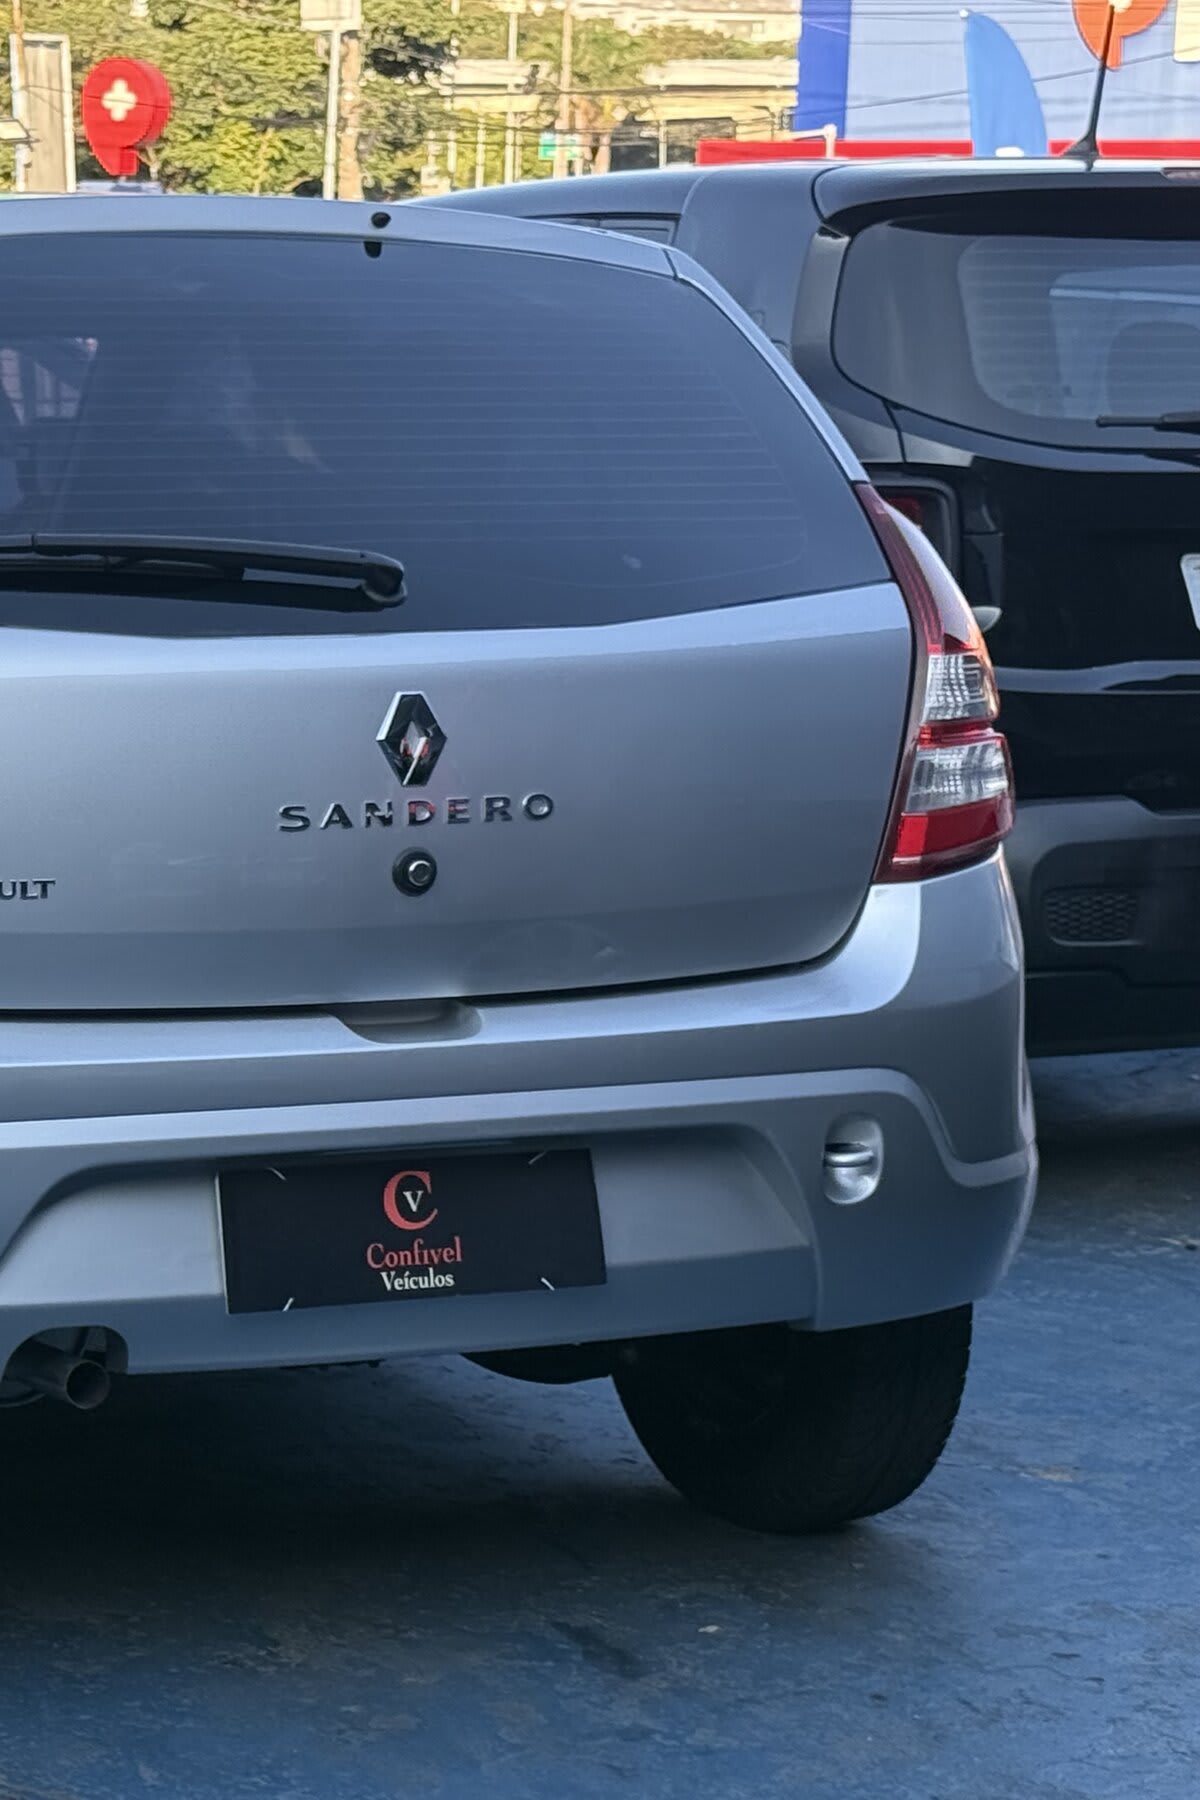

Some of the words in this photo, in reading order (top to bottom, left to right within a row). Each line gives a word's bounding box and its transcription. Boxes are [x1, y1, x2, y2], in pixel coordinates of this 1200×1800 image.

[280, 793, 554, 833] SANDERO
[367, 1237, 462, 1269] Confivel
[380, 1268, 455, 1291] Veículos
